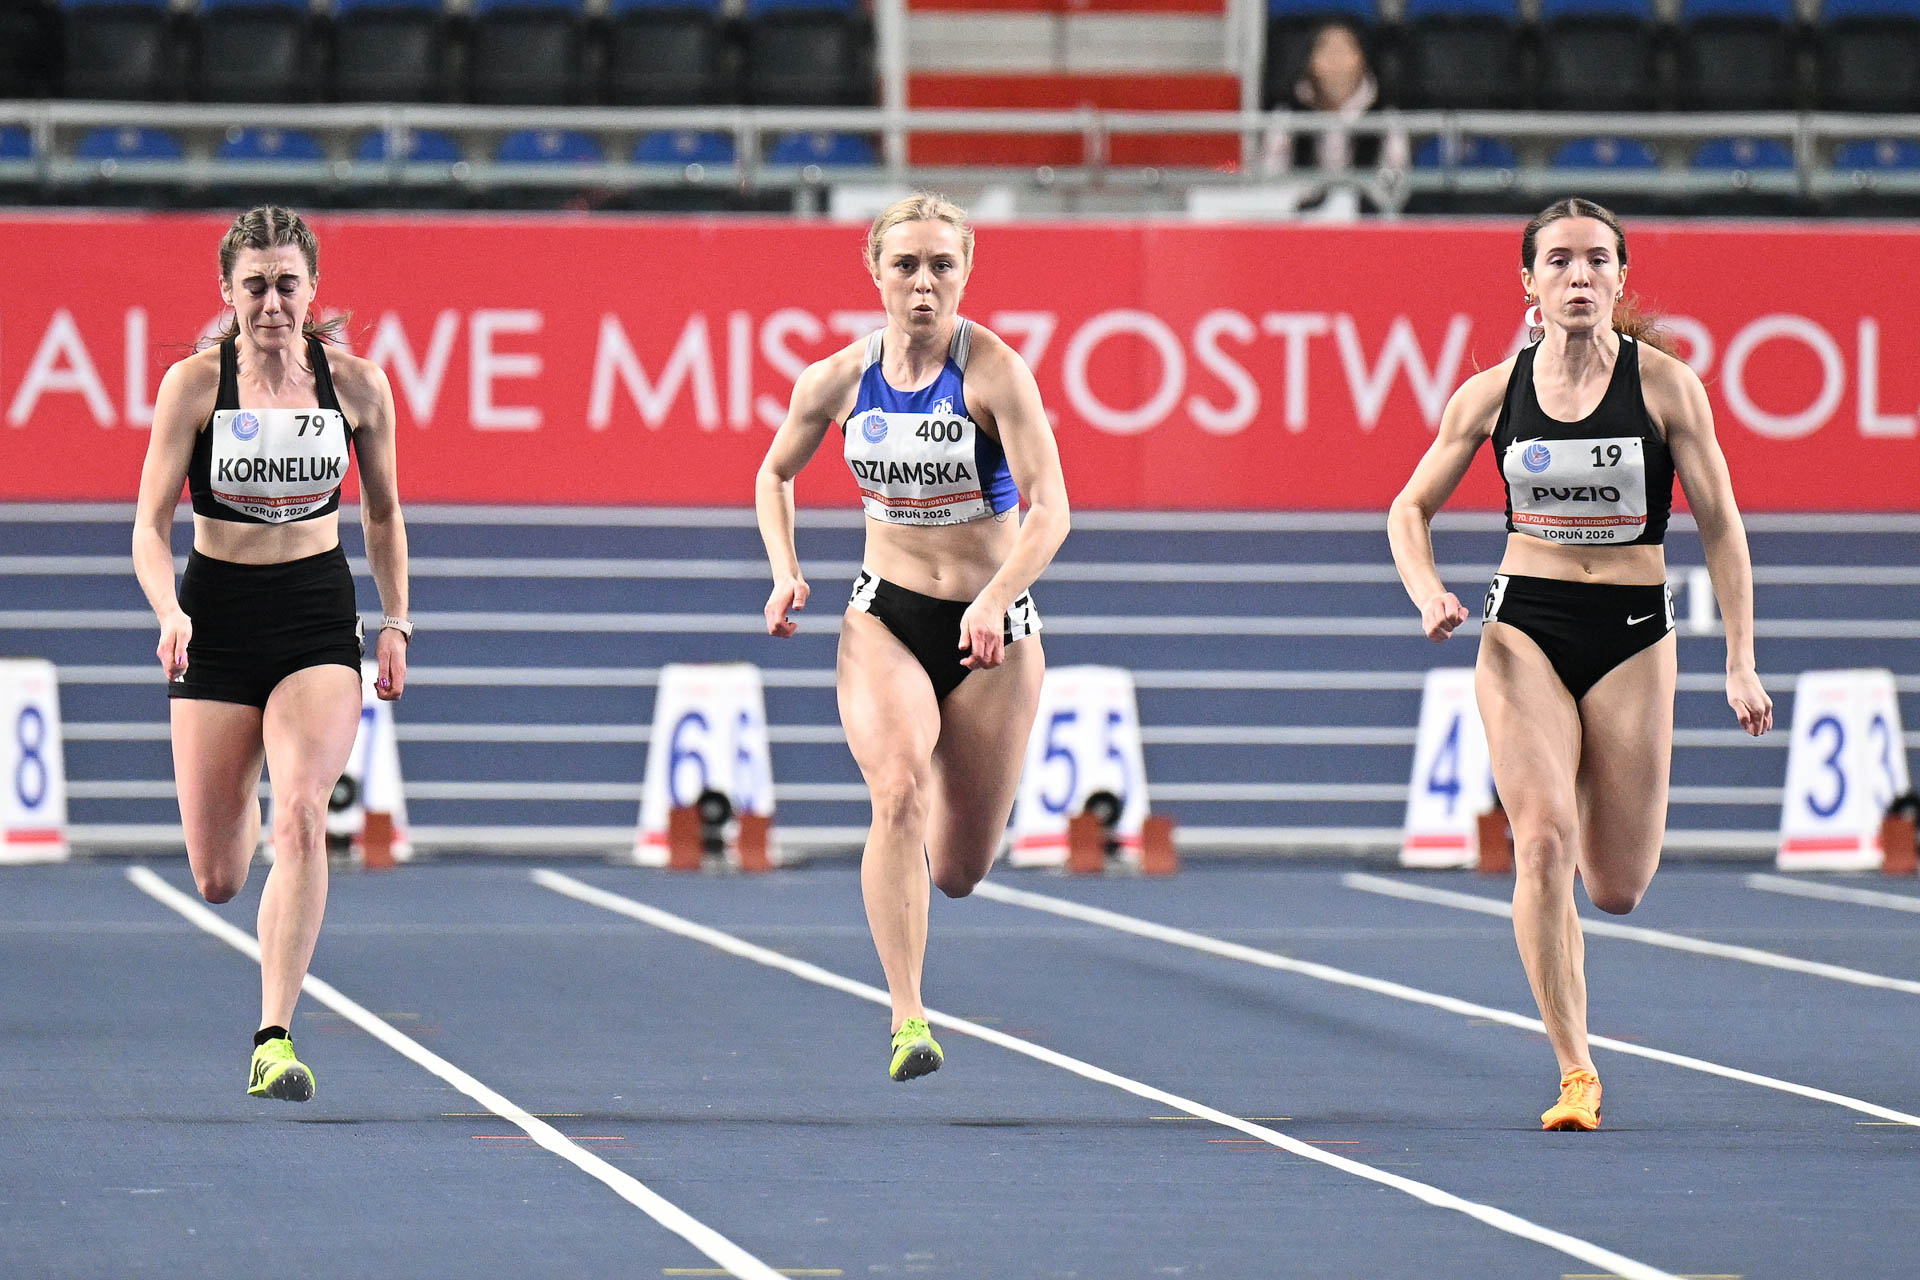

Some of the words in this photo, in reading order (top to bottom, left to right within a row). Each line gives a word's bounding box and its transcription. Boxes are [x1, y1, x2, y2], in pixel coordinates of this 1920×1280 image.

[6, 306, 544, 430] ALWE
[295, 415, 325, 437] 79
[915, 420, 963, 443] 400
[1591, 444, 1622, 468] 19
[217, 456, 341, 483] KORNELUK
[851, 459, 972, 486] DZIAMSKA
[1532, 486, 1621, 503] PUZIO
[243, 505, 283, 519] TORUŃ
[284, 506, 310, 516] 2026
[885, 508, 920, 518] TORUŃ
[923, 509, 951, 519] 2026
[1517, 514, 1528, 522] 70.
[1529, 515, 1545, 524] PZLA
[1546, 517, 1573, 525] Halowe
[1575, 518, 1619, 526] Mistrzostwa
[1621, 516, 1643, 524] Polski
[1543, 529, 1583, 540] TORUŃ
[1586, 530, 1615, 539] 2026
[16, 706, 47, 809] 8
[670, 711, 709, 807] 6
[1041, 712, 1077, 813] 5
[1428, 714, 1460, 815] 4
[1808, 716, 1845, 818] 3
